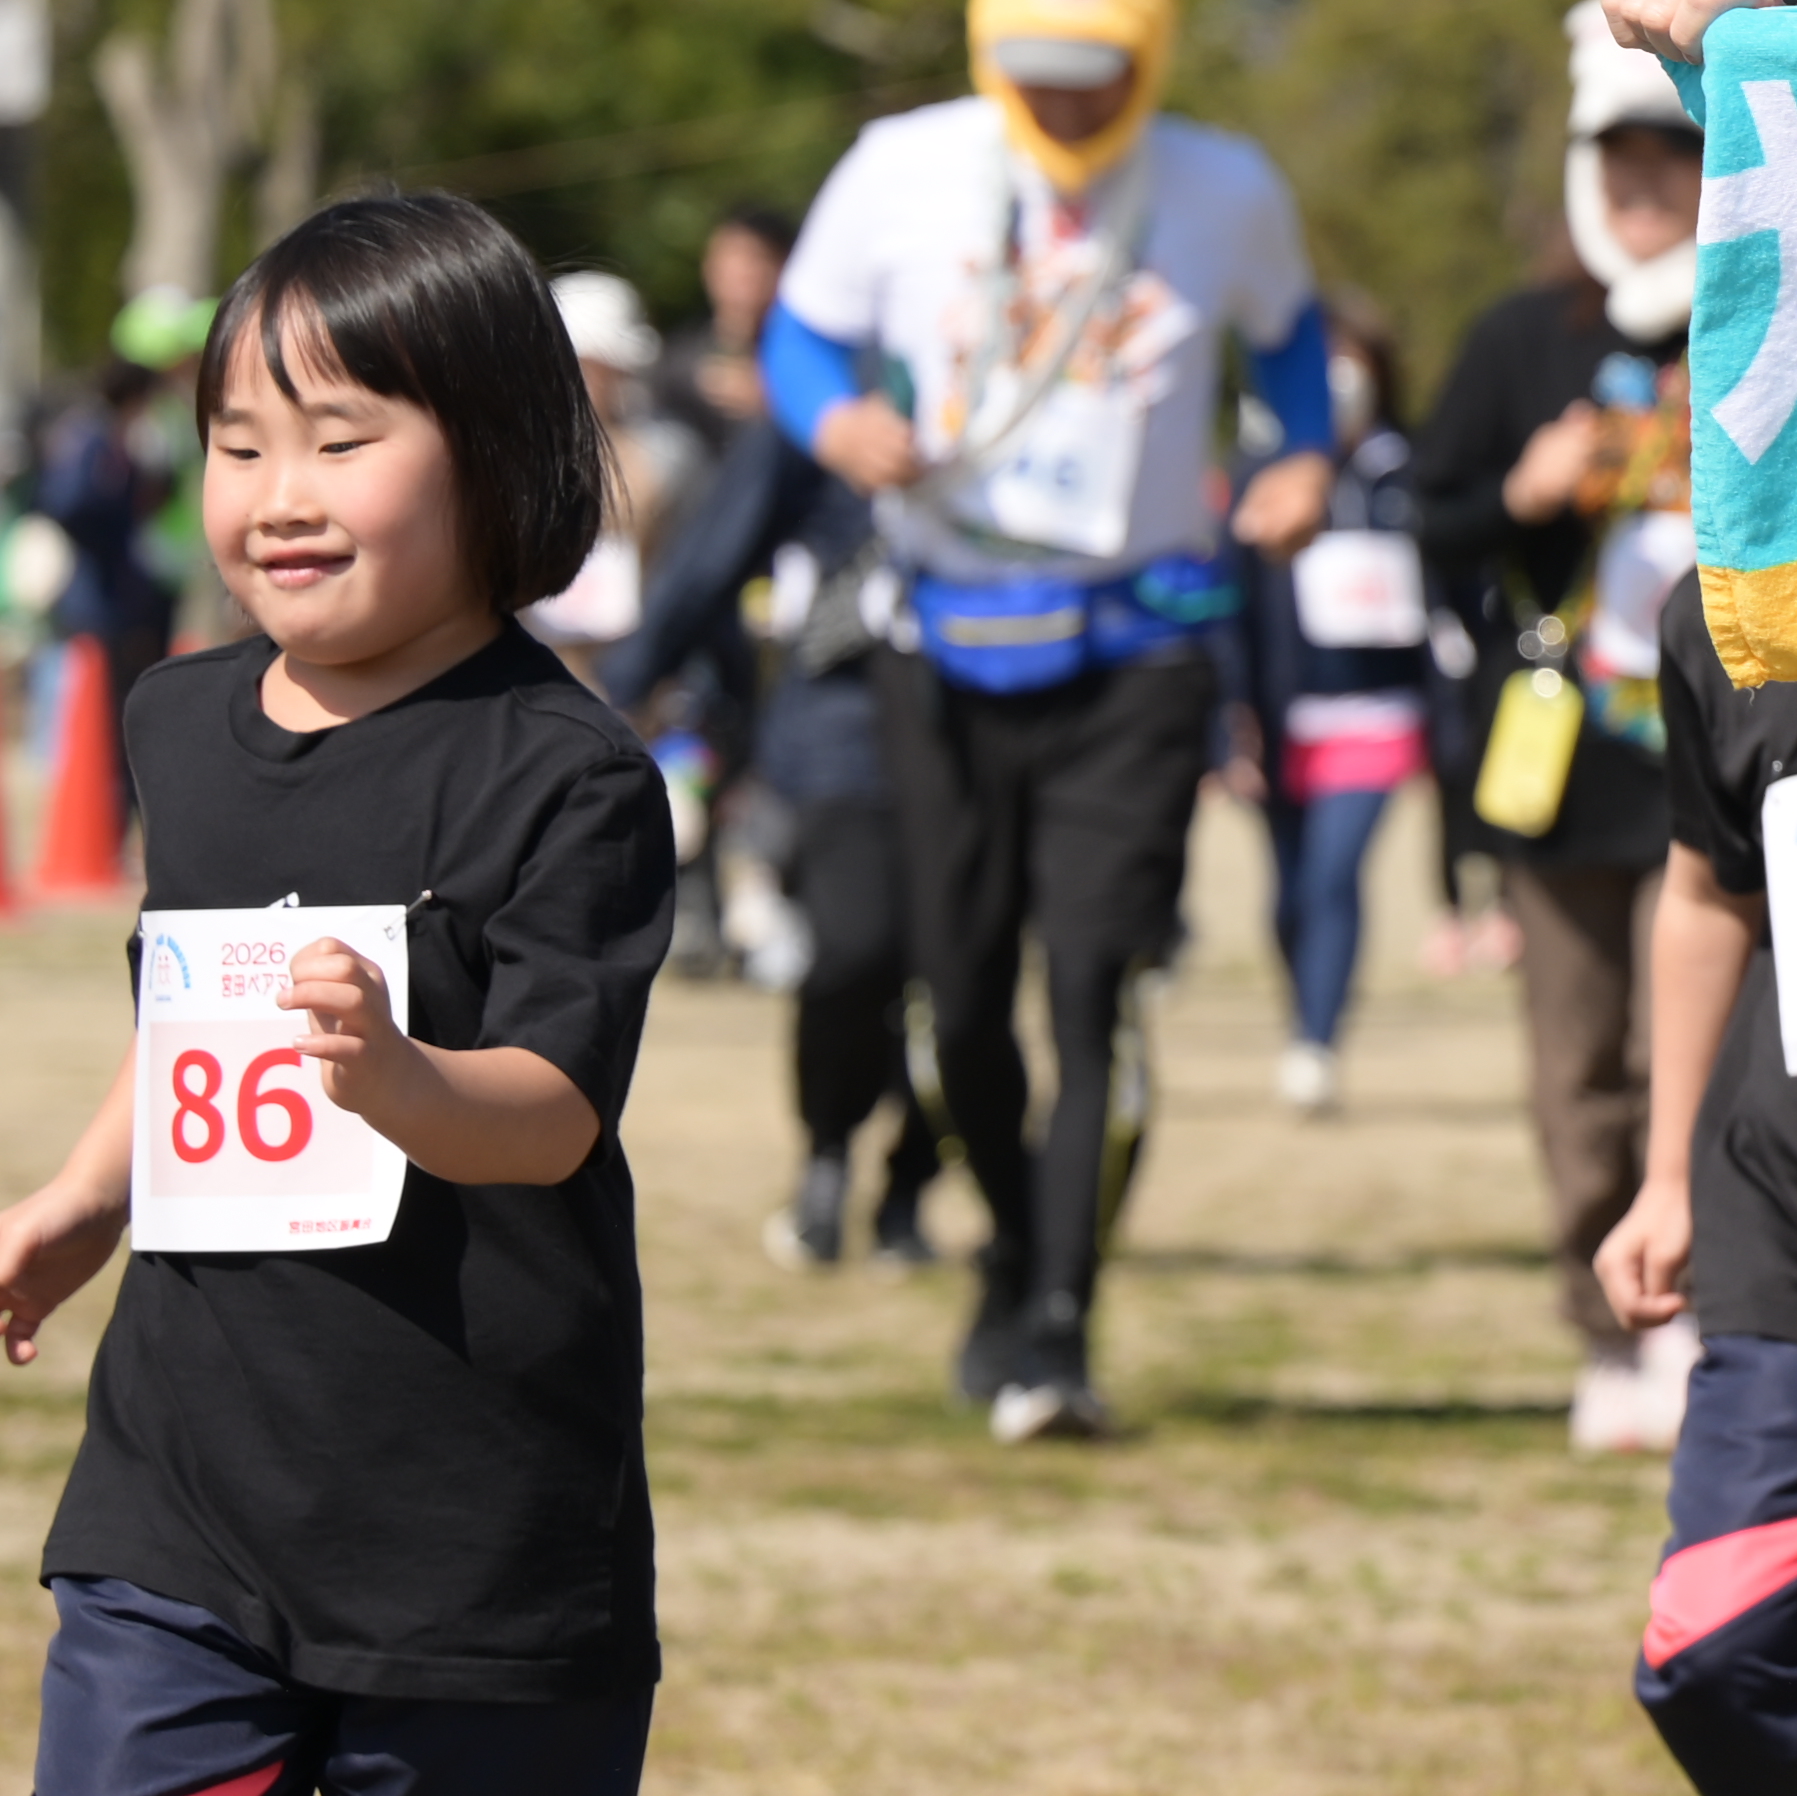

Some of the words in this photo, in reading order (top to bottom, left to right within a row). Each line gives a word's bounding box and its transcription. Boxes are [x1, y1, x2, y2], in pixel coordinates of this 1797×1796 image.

[221, 941, 286, 966] 2026
[221, 972, 290, 998] 宮田ペアマ
[171, 1047, 313, 1165] 86
